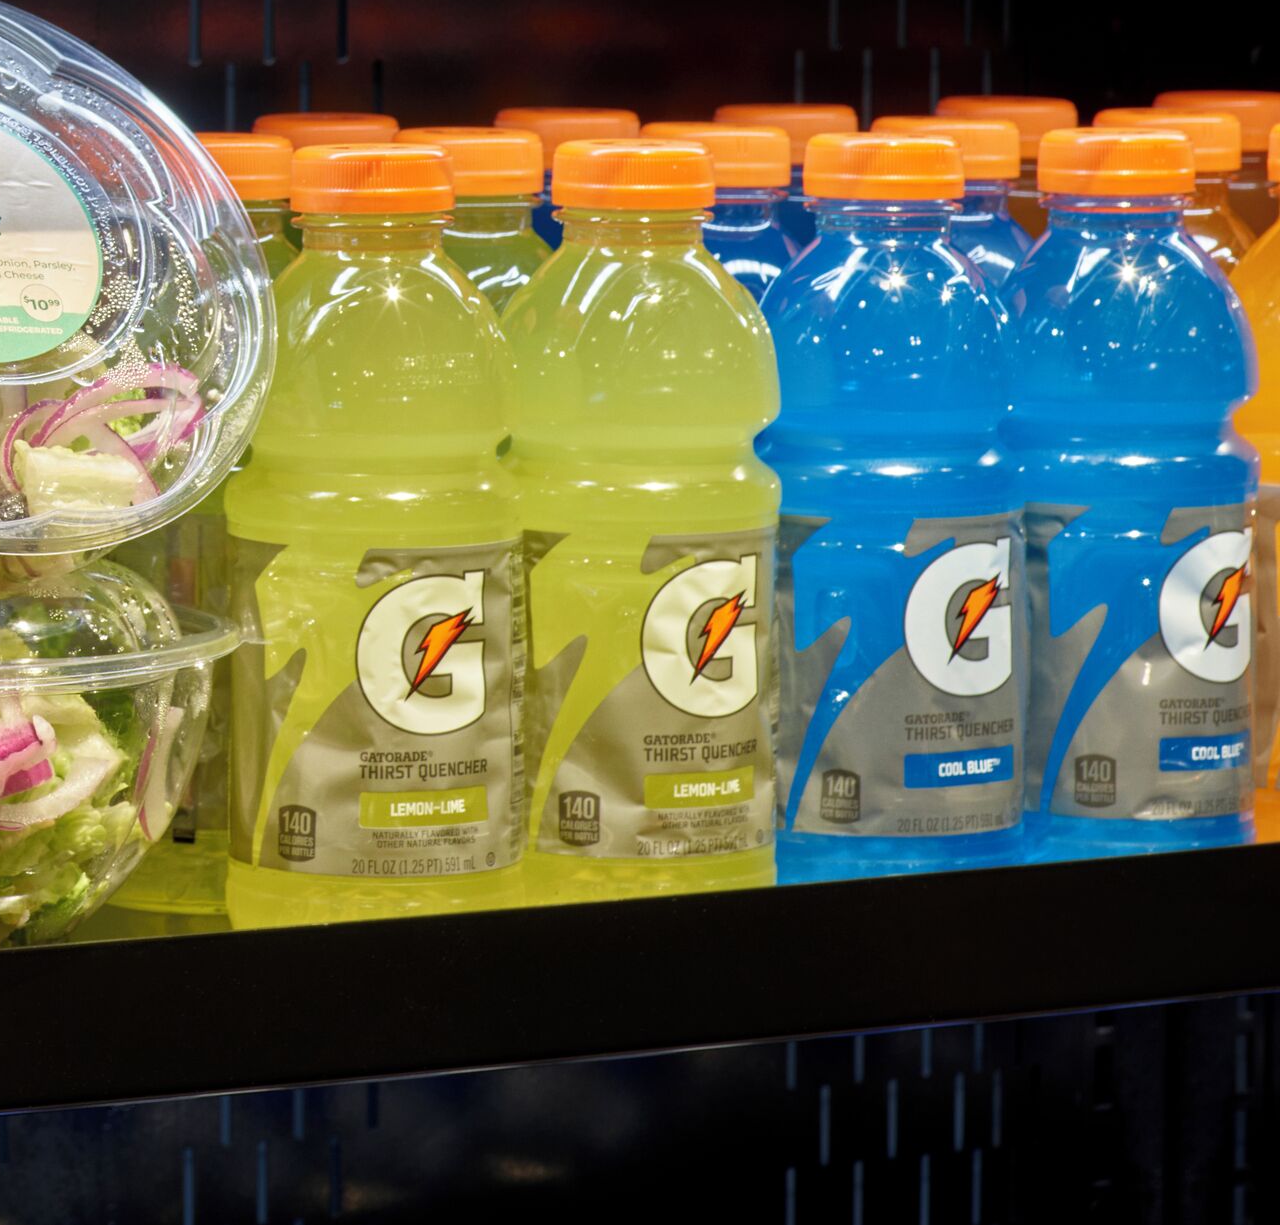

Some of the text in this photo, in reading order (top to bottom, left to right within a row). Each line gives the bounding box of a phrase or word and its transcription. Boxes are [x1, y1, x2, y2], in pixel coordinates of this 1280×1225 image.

[4, 270, 44, 280] Cheese
[34, 260, 76, 272] Parsley,
[1159, 528, 1252, 684] G
[905, 536, 1012, 697] G
[640, 556, 759, 718] G
[356, 569, 485, 735] G
[905, 712, 964, 725] GATORADE
[1159, 710, 1209, 726] THIRST
[644, 733, 711, 746] GATORADE
[905, 718, 1014, 741] THIRST QUENCHER
[360, 751, 428, 762] GATORADE
[644, 739, 757, 763] THIRST QUENCHER
[1191, 746, 1220, 761] COOL
[360, 759, 488, 781] THIRST QUENCHER
[938, 761, 966, 777] COOL
[1080, 760, 1111, 782] 140
[673, 779, 741, 798] LEMON-LIME
[827, 775, 856, 797] 140
[390, 799, 466, 817] LEMON-LIME
[563, 796, 595, 819] 140
[282, 810, 311, 835] 140
[352, 859, 365, 874] 20
[368, 860, 380, 875] FL
[382, 859, 396, 874] OZ
[399, 858, 424, 875] (1.25
[427, 858, 443, 873] PT)
[445, 856, 461, 872] 591
